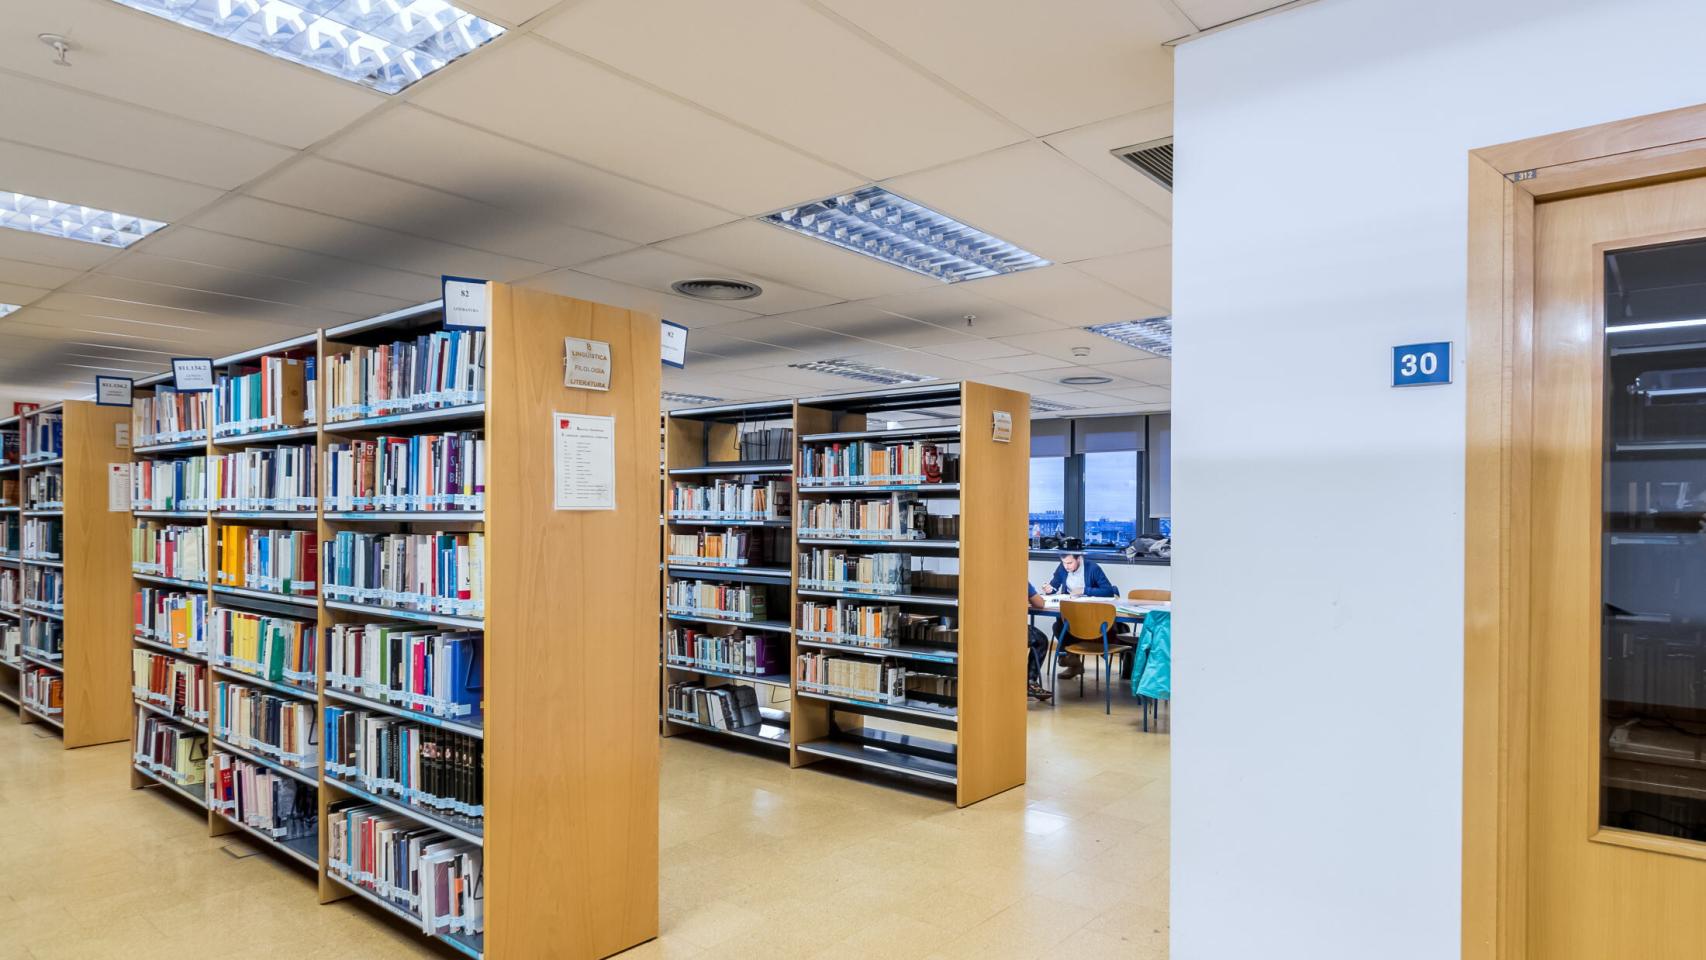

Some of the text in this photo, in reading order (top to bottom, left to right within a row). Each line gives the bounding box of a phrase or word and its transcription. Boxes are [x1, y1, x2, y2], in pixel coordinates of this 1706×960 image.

[1519, 171, 1533, 180] 312
[1401, 352, 1437, 376] 30
[570, 379, 606, 387] LITERATURA
